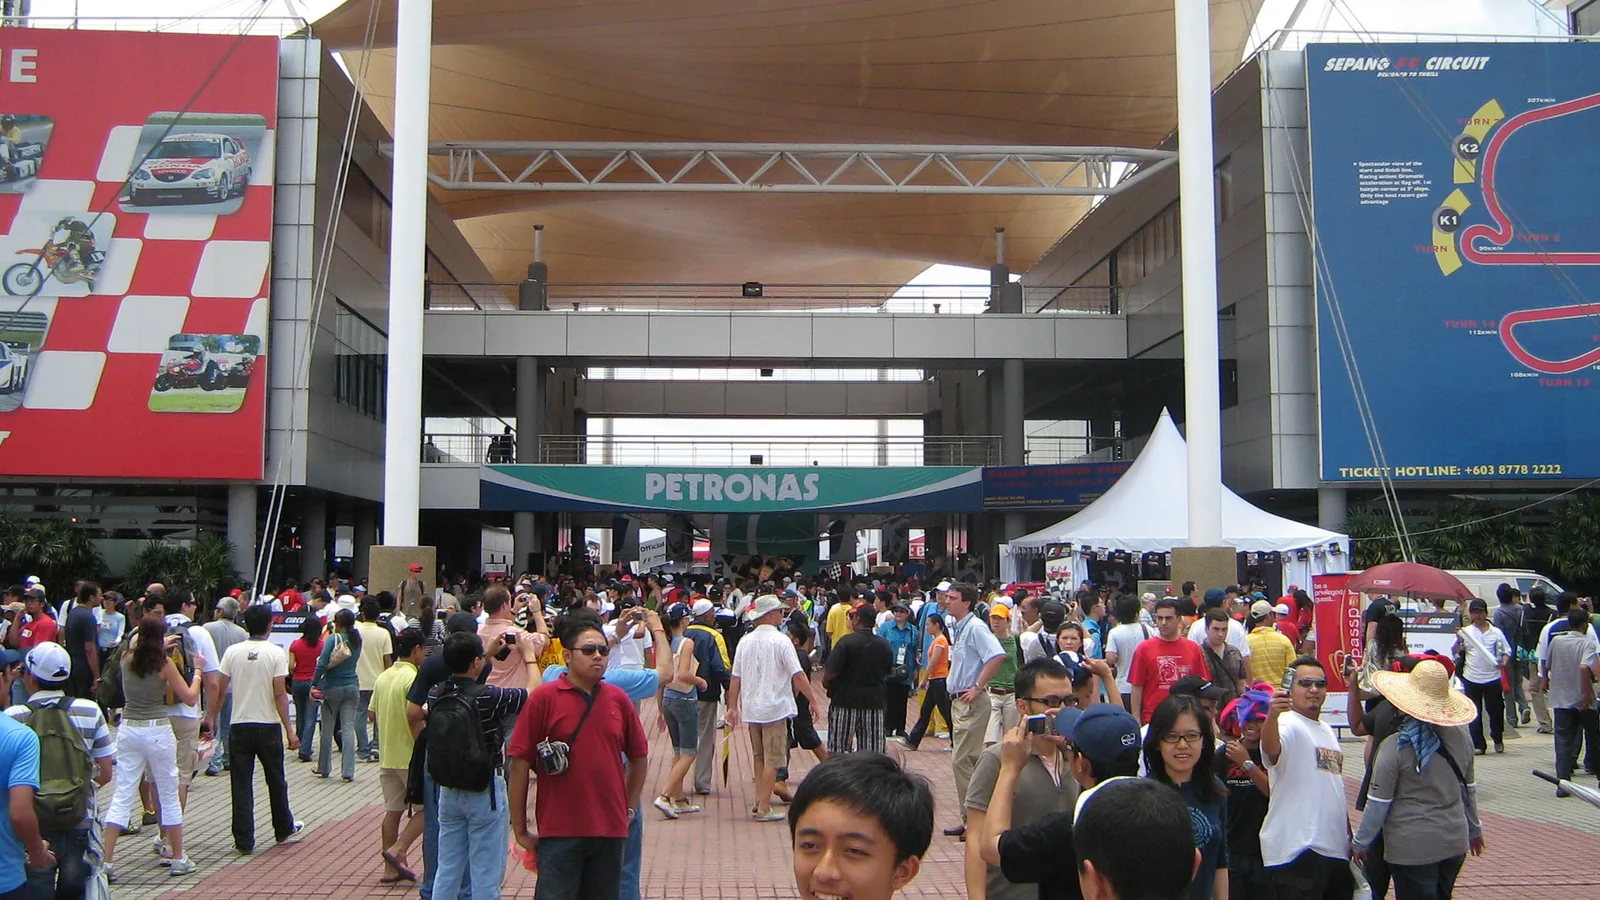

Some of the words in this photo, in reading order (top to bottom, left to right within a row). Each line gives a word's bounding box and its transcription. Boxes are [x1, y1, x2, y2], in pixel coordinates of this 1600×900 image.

[1324, 57, 1390, 71] SEPANG
[1425, 56, 1490, 70] CIRCUIT
[1460, 144, 1479, 153] K2
[1440, 215, 1458, 225] K1
[1517, 233, 1549, 242] TURN
[1415, 245, 1448, 253] TURN
[1444, 320, 1478, 328] TURN
[1539, 379, 1572, 387] TURN
[1339, 467, 1390, 478] TICKET
[1395, 466, 1461, 477] HOTLINE:
[1465, 465, 1494, 475] +603
[1499, 465, 1528, 475] 8778
[1532, 464, 1562, 474] 2222
[645, 473, 820, 501] PETRONAS
[640, 541, 665, 553] Official
[1314, 589, 1343, 597] privileged
[285, 616, 306, 624] CIRCU
